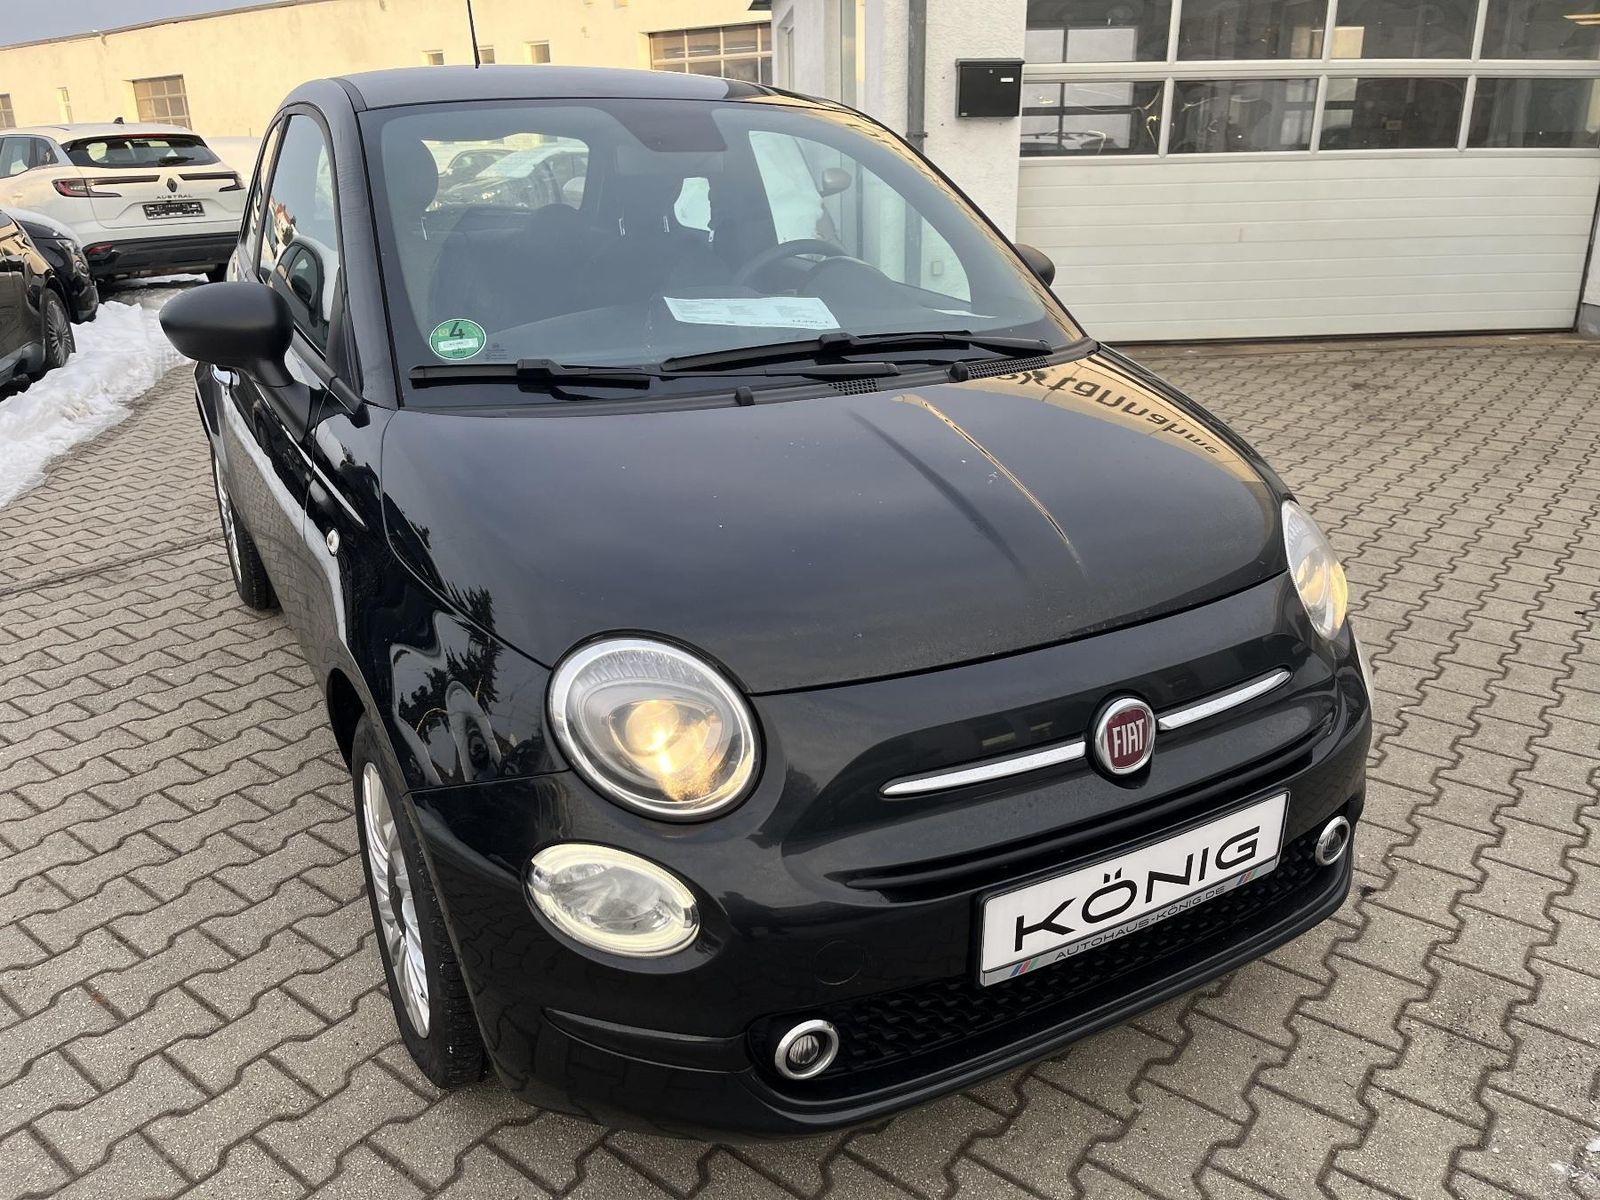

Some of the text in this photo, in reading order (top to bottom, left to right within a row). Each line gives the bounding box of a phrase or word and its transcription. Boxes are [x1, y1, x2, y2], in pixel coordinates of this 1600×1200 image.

[449, 321, 465, 339] 4
[1112, 718, 1145, 759] FIAT
[1014, 825, 1261, 952] KÖNIG
[1054, 886, 1226, 960] AUTOHAUS-KÖNIG.DE
